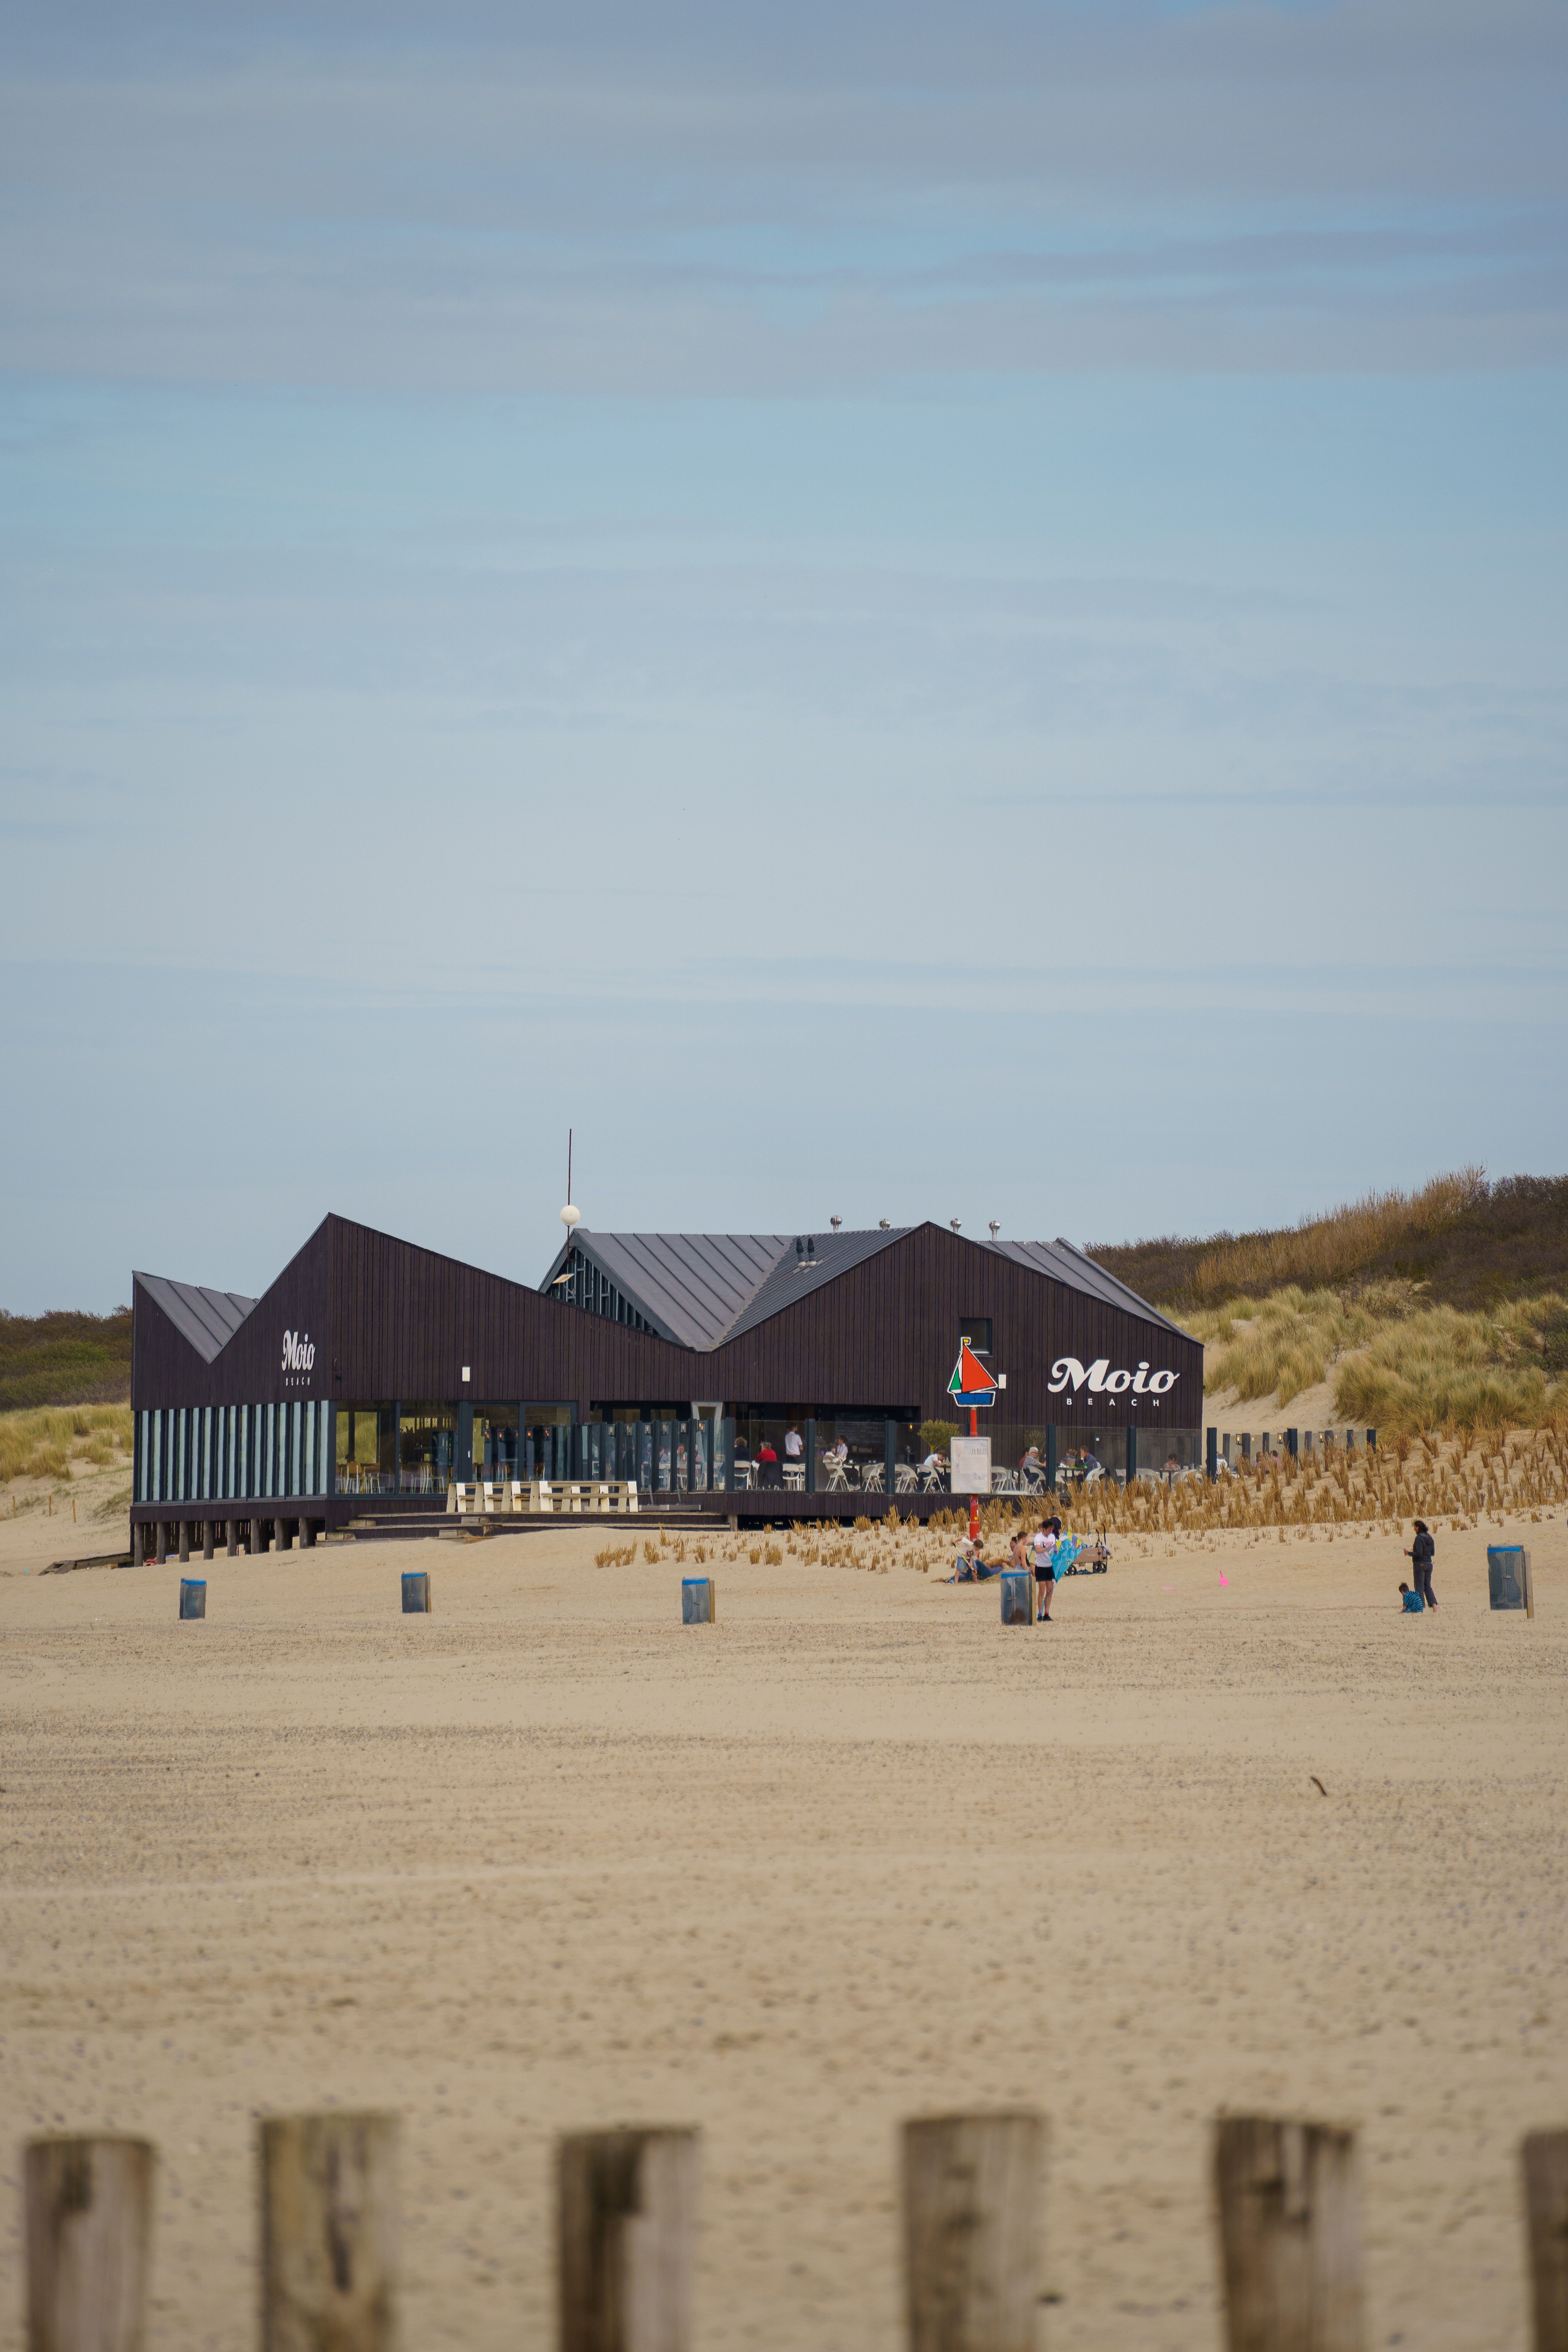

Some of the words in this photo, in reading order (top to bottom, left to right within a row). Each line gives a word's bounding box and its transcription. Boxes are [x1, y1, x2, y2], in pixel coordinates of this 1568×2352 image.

[281, 1330, 316, 1371] Moio
[286, 1377, 310, 1386] BEACH
[1048, 1358, 1180, 1393] Moio
[1067, 1398, 1159, 1406] BEACH
